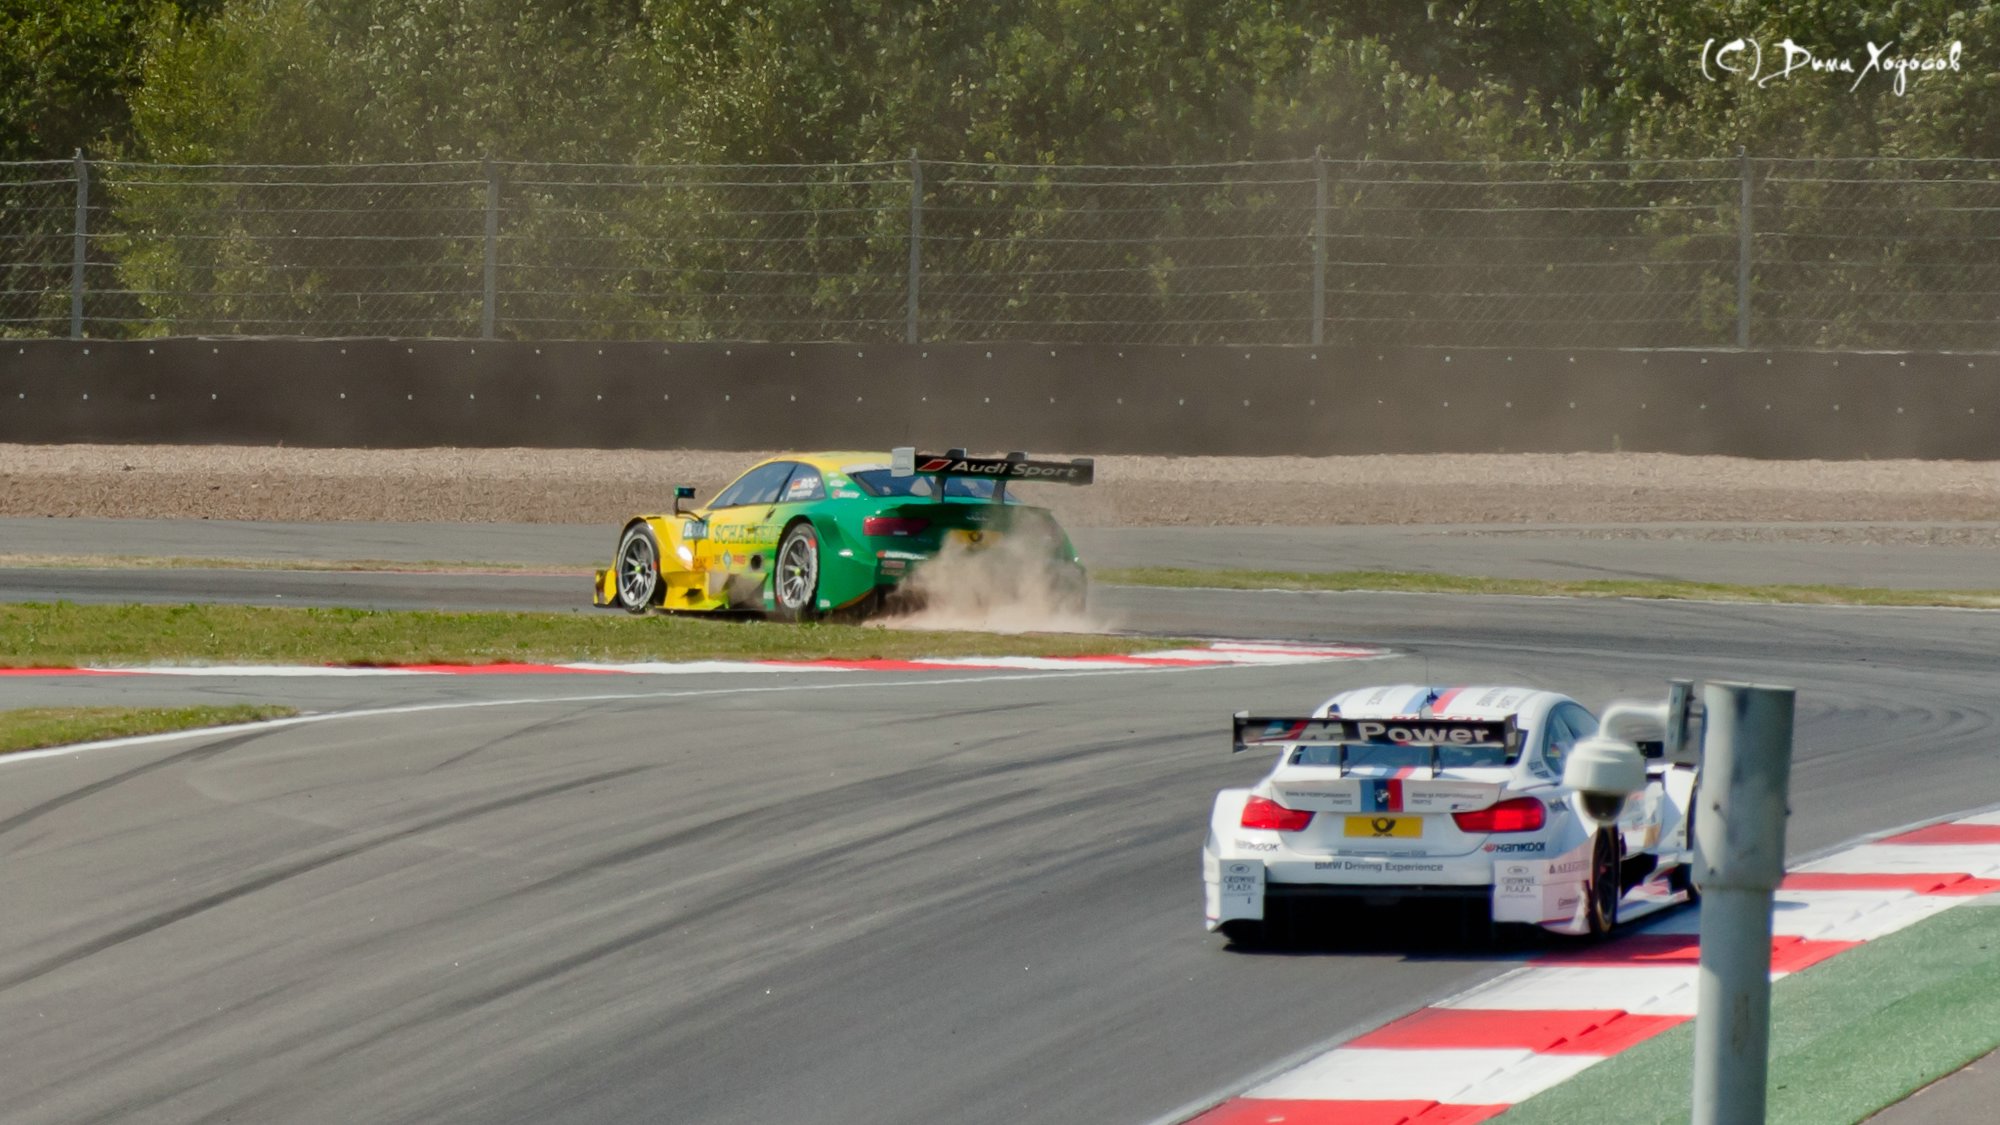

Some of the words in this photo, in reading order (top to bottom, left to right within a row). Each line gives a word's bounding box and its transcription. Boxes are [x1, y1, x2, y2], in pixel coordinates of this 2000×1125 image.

[951, 460, 1006, 475] Audi
[1011, 463, 1079, 478] Sport
[1357, 721, 1490, 744] Power
[1315, 861, 1342, 871] BMW
[1344, 861, 1383, 873] Driving
[1385, 862, 1444, 873] Experience
